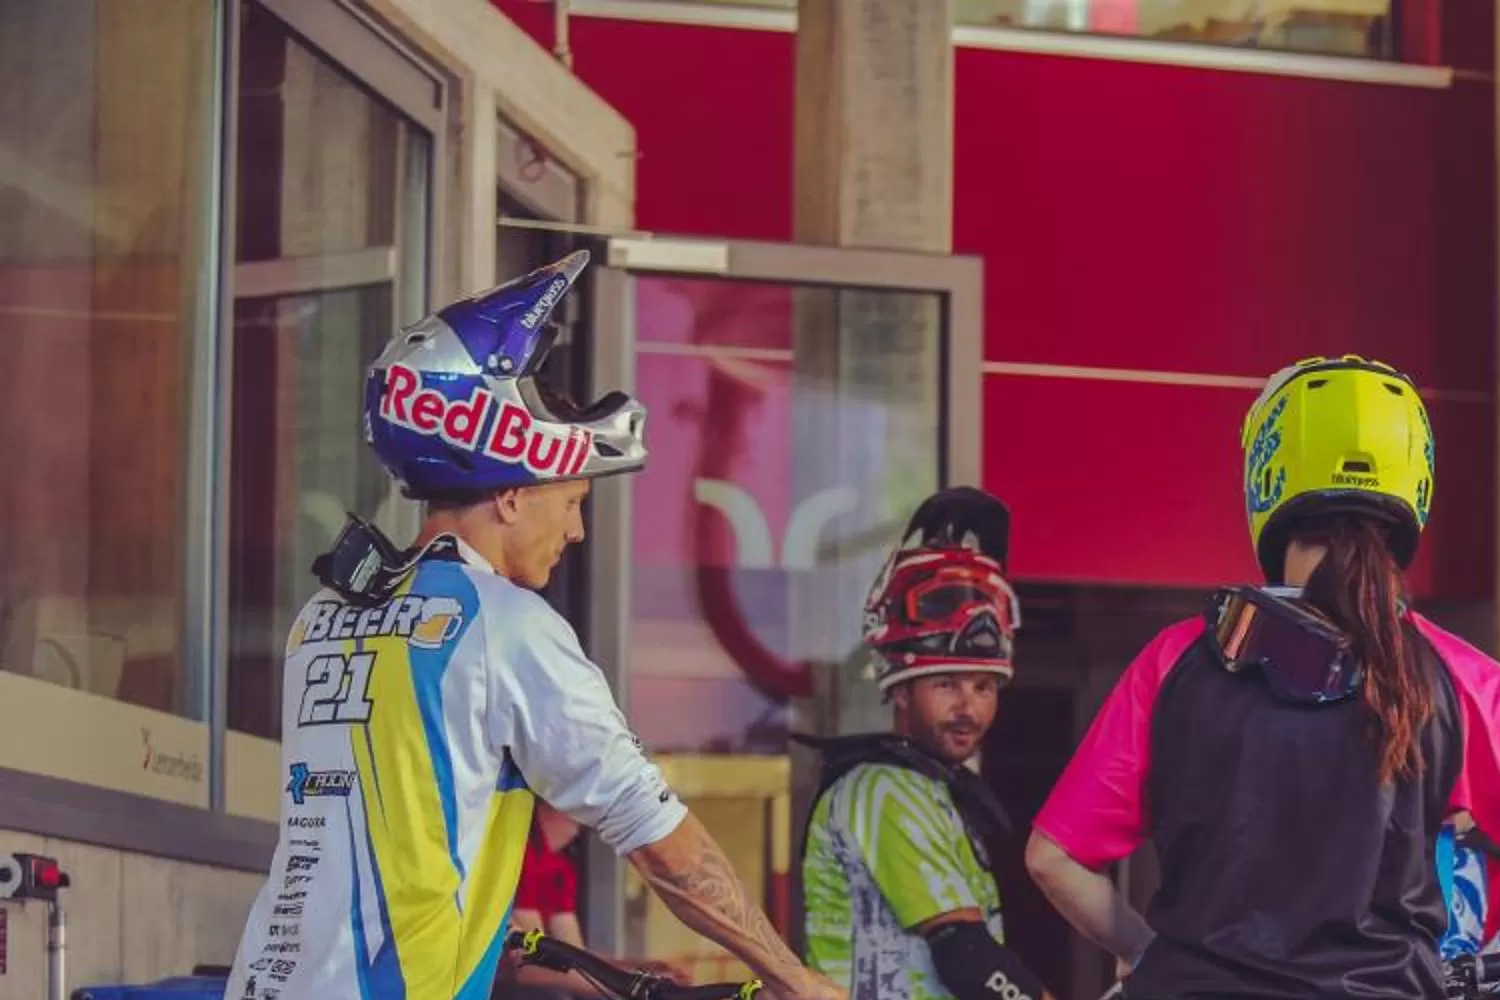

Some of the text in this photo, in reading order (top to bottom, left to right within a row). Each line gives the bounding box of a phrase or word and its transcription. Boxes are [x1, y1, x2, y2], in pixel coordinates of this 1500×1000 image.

[381, 365, 594, 477] Red Bull
[301, 594, 423, 645] BEER
[298, 651, 378, 728] 21
